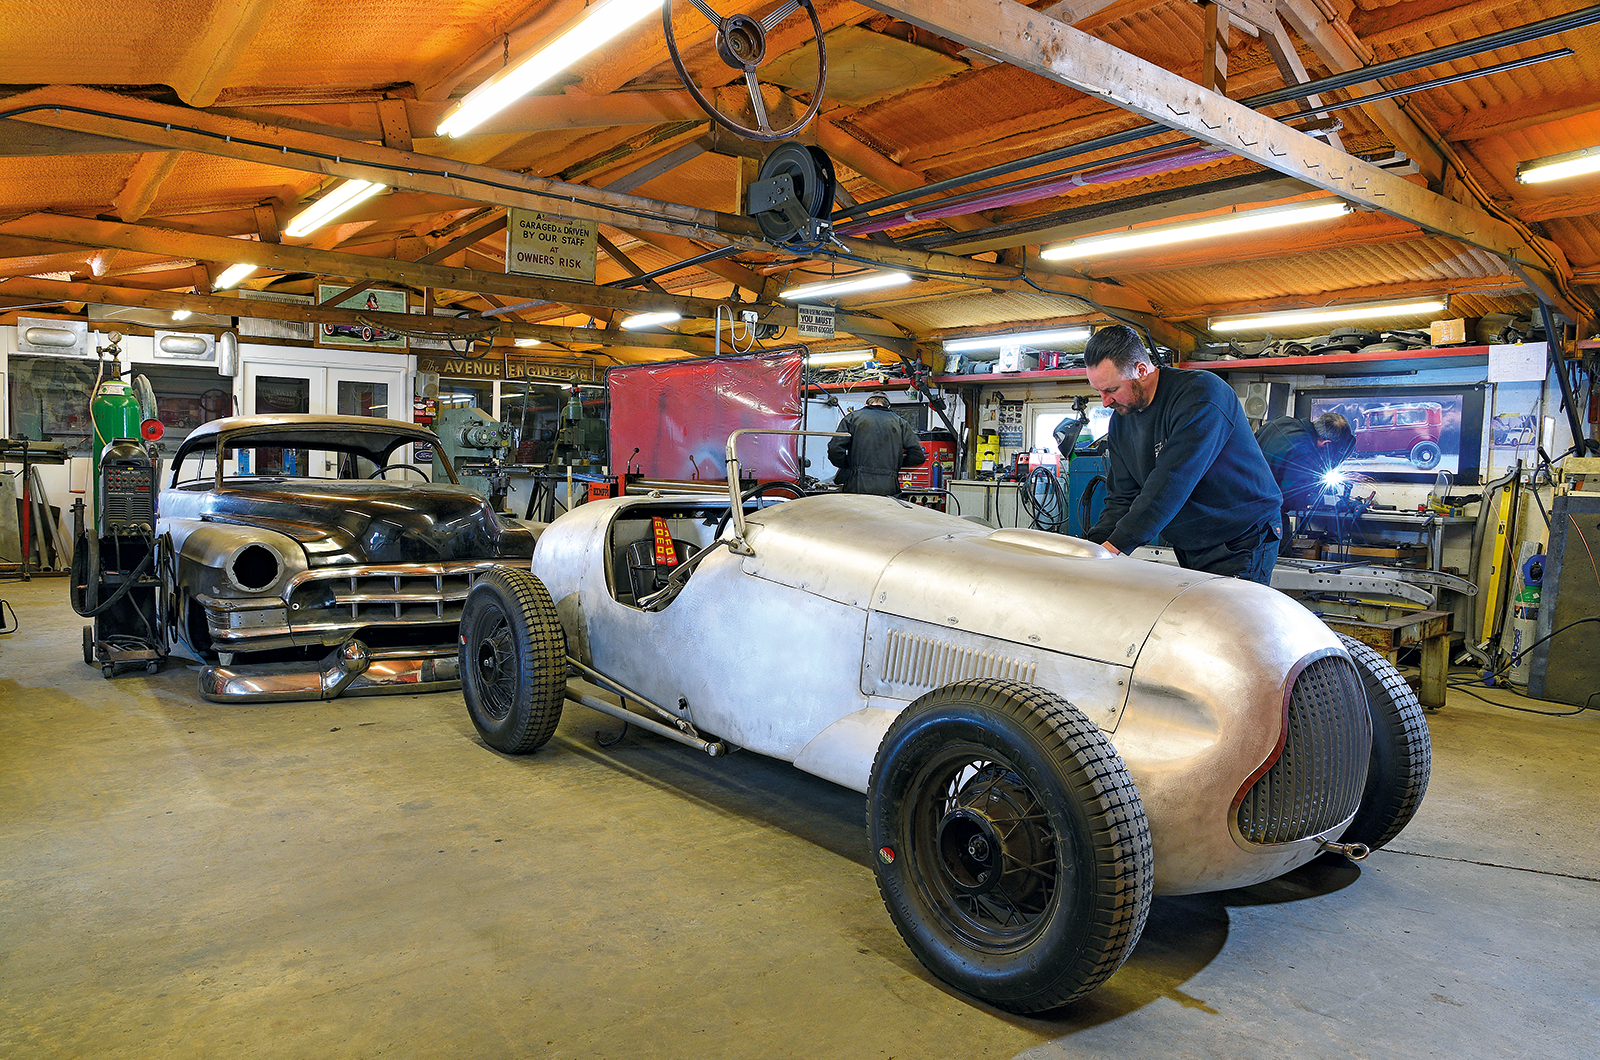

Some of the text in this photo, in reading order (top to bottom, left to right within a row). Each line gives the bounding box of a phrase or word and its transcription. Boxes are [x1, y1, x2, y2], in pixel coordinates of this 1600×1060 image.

[520, 220, 557, 232] GARAGED
[564, 226, 590, 237] DRIVEN
[523, 230, 584, 246] BY OUR STAFF
[517, 252, 582, 268] OWNERS RISK
[815, 316, 832, 324] MUST
[422, 358, 440, 372] The
[444, 361, 501, 376] AVENUE
